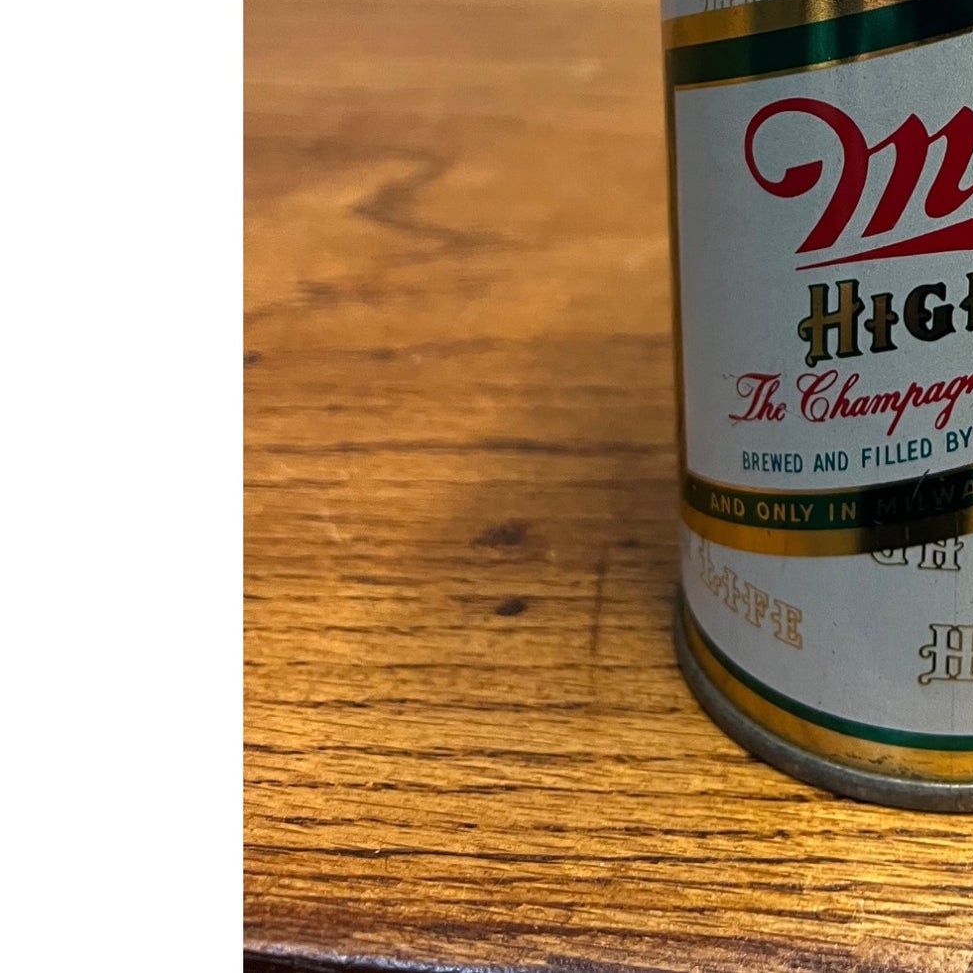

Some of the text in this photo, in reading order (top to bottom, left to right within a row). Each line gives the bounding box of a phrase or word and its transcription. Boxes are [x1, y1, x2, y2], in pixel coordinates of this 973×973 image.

[728, 372, 788, 425] The
[742, 450, 803, 474] BREWED
[813, 451, 849, 472] AND
[861, 437, 932, 468] FILLED
[946, 426, 973, 454] BY
[710, 492, 746, 518] AND
[757, 501, 814, 523] ONLY
[828, 501, 857, 521] IN
